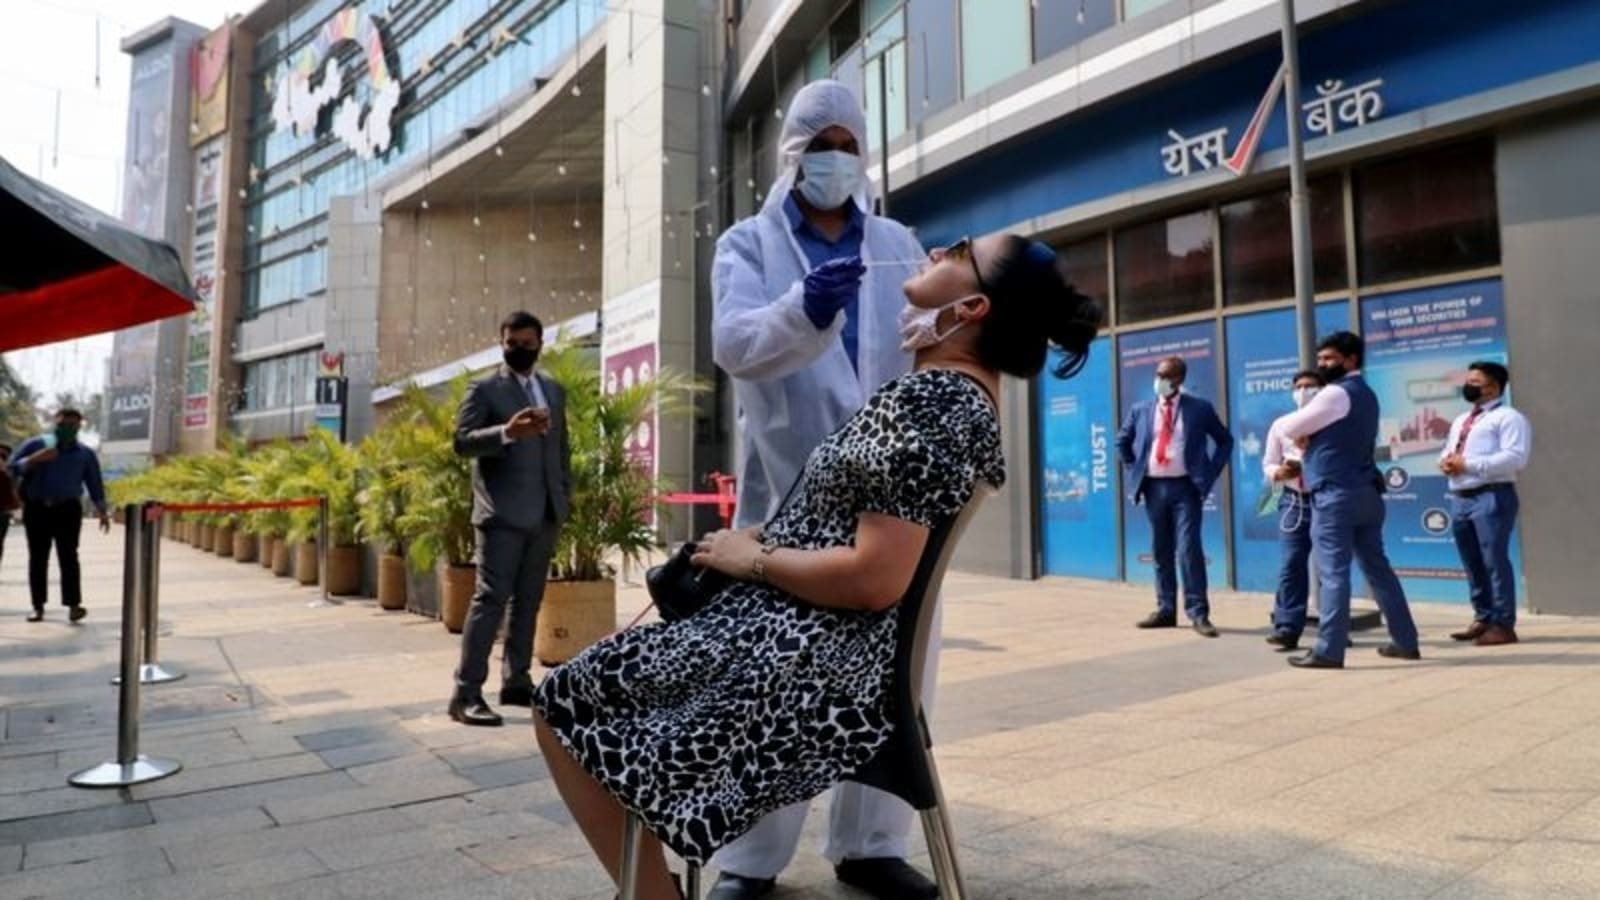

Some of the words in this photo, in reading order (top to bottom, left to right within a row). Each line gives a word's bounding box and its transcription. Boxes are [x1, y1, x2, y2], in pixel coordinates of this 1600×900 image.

[1161, 127, 1228, 176] येस
[1245, 377, 1292, 393] ETHIC
[113, 394, 152, 411] ALDO
[1091, 423, 1107, 493] TRUST
